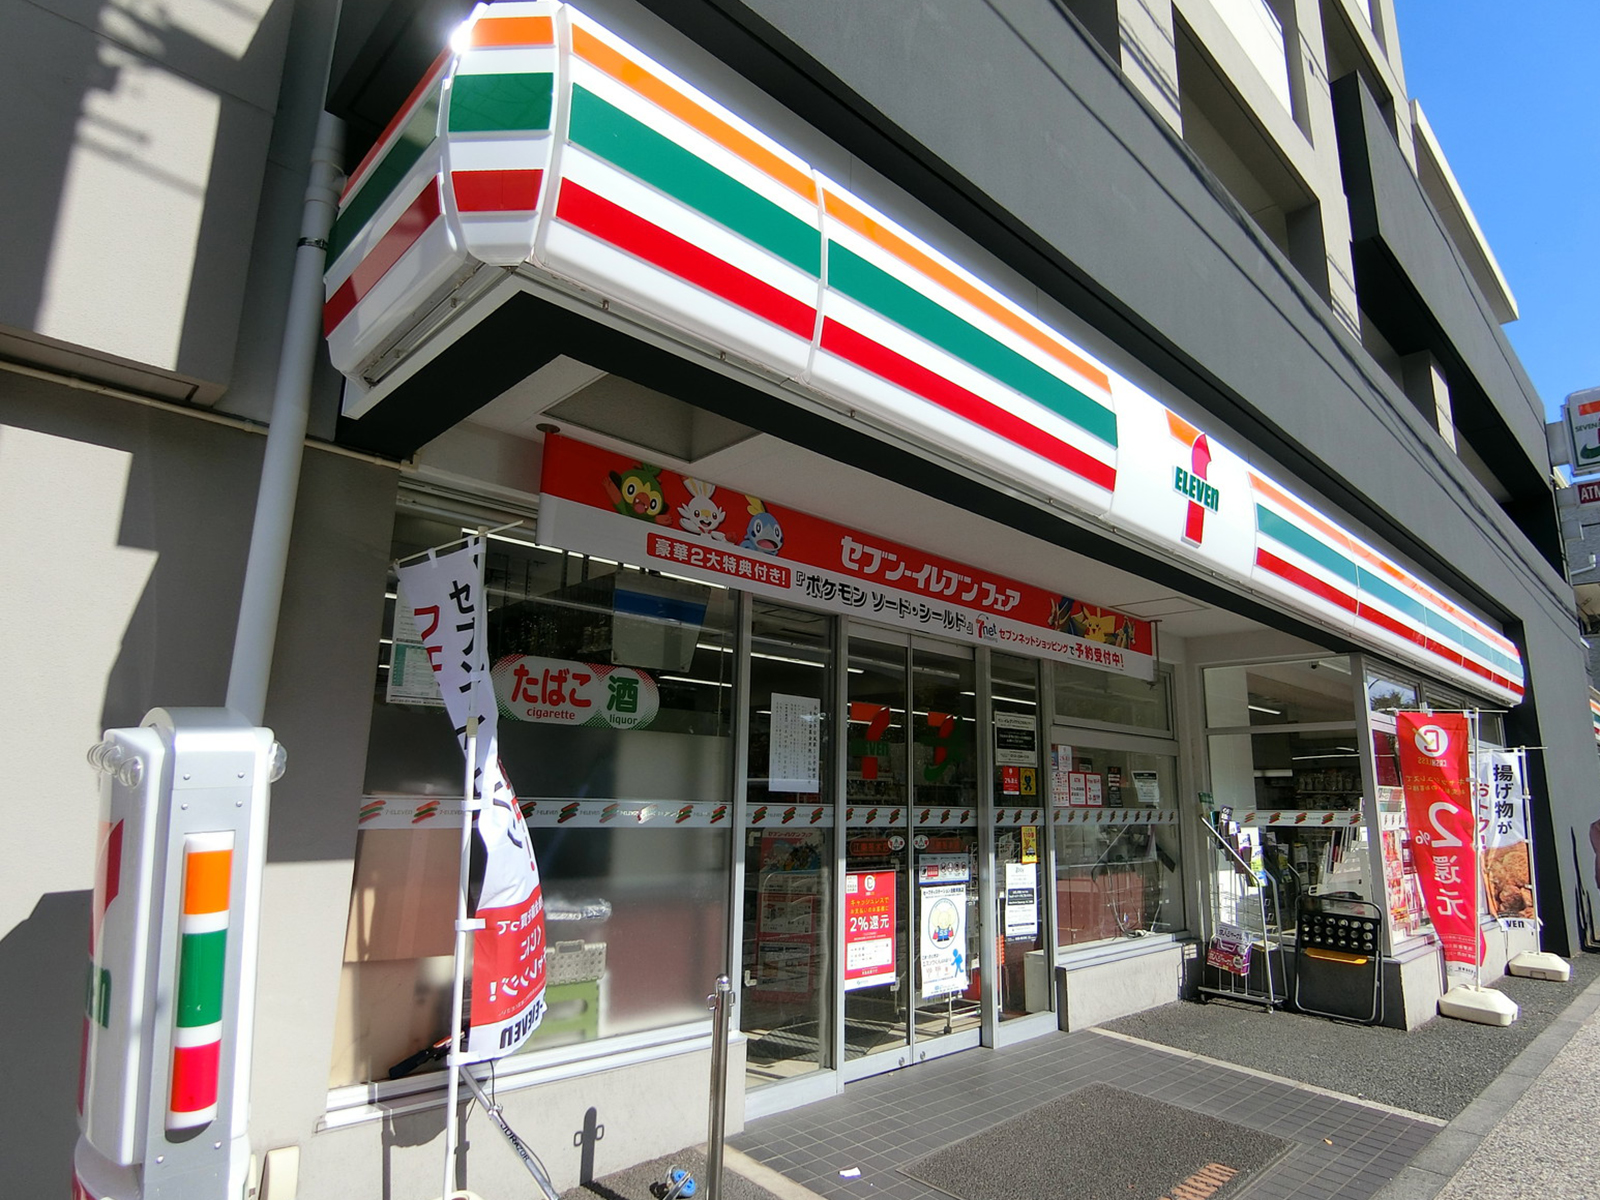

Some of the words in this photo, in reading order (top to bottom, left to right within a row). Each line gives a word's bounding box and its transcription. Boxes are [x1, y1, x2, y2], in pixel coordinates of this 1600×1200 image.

[512, 664, 593, 708] たばこ
[606, 674, 639, 713] 酒
[526, 707, 576, 722] cigarette
[609, 713, 638, 727] liquor
[1493, 763, 1513, 834] 揚げ物が
[850, 914, 890, 932] 2%還元
